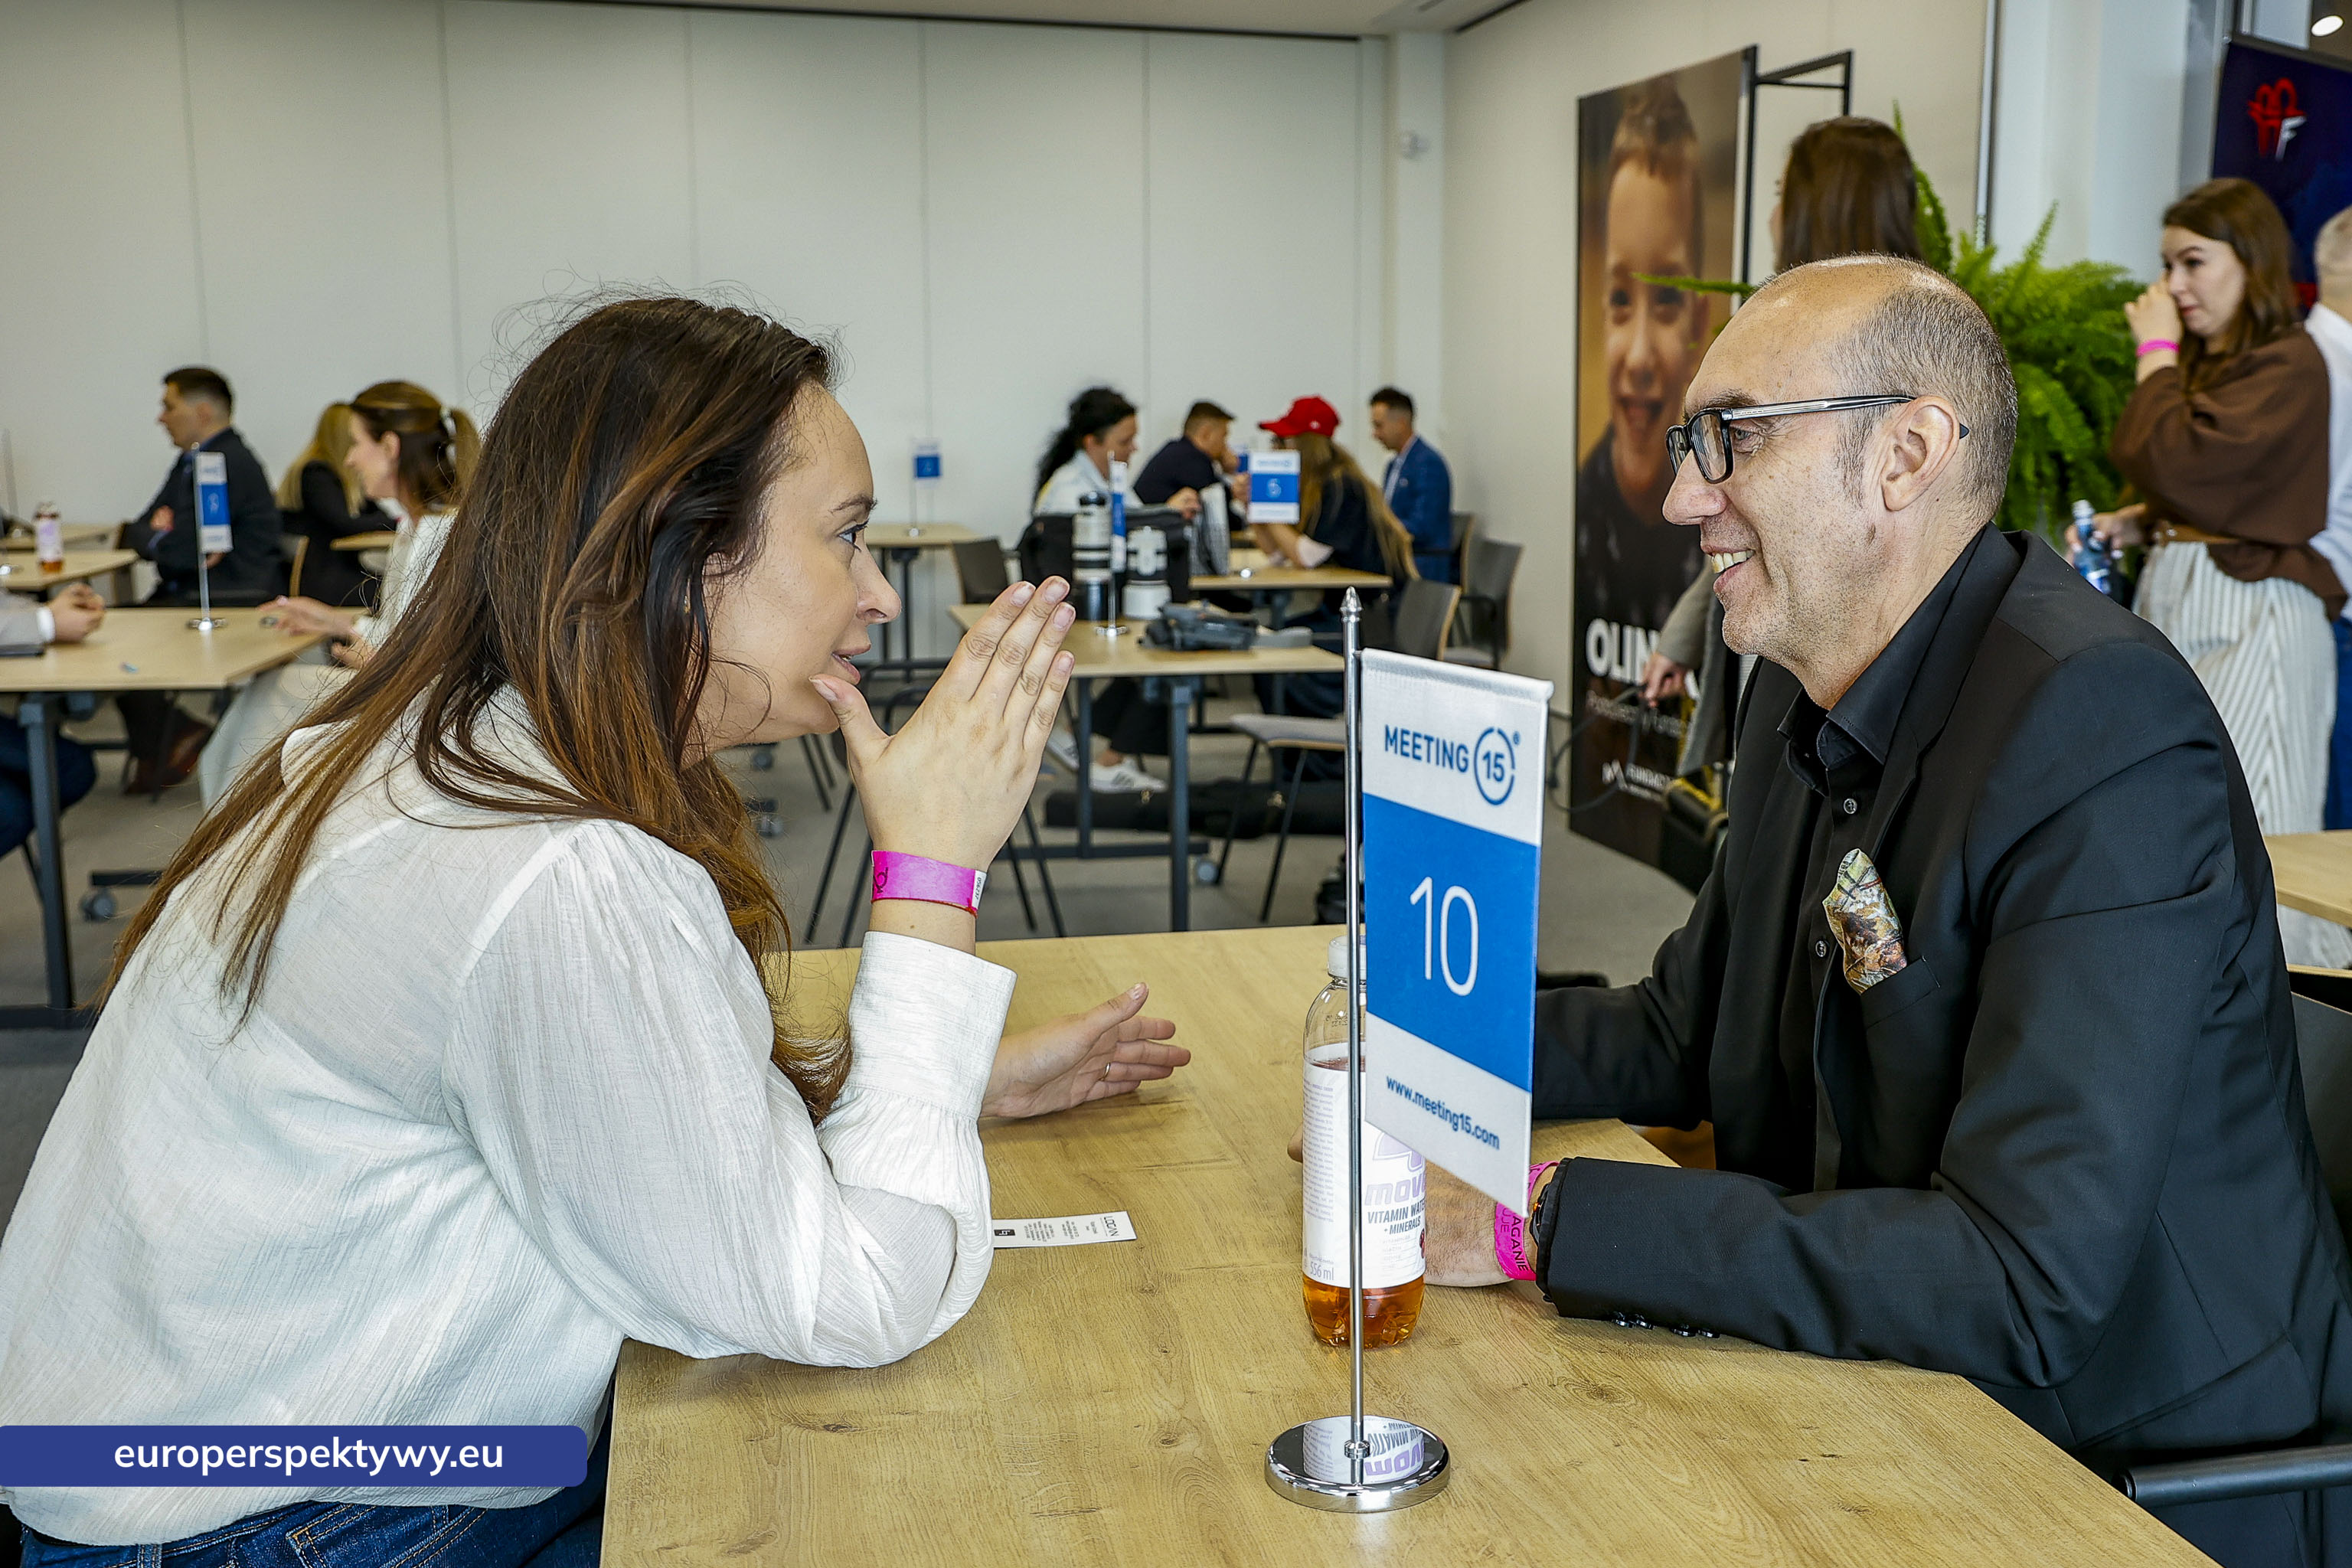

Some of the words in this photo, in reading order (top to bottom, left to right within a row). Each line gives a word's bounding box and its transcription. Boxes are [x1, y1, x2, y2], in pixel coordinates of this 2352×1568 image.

[1384, 724, 1469, 773] MEETING
[1482, 750, 1505, 782] 15
[1410, 876, 1479, 996] 10
[1387, 1075, 1500, 1150] www.meeting15.com
[1367, 1206, 1409, 1224] VITAMIN
[1411, 1197, 1426, 1217] WATE
[1389, 1216, 1421, 1234] MINERALS
[1500, 1207, 1511, 1233] UJE
[1511, 1215, 1529, 1272] AGANIE
[1310, 1261, 1321, 1278] 556
[1323, 1267, 1334, 1280] ml
